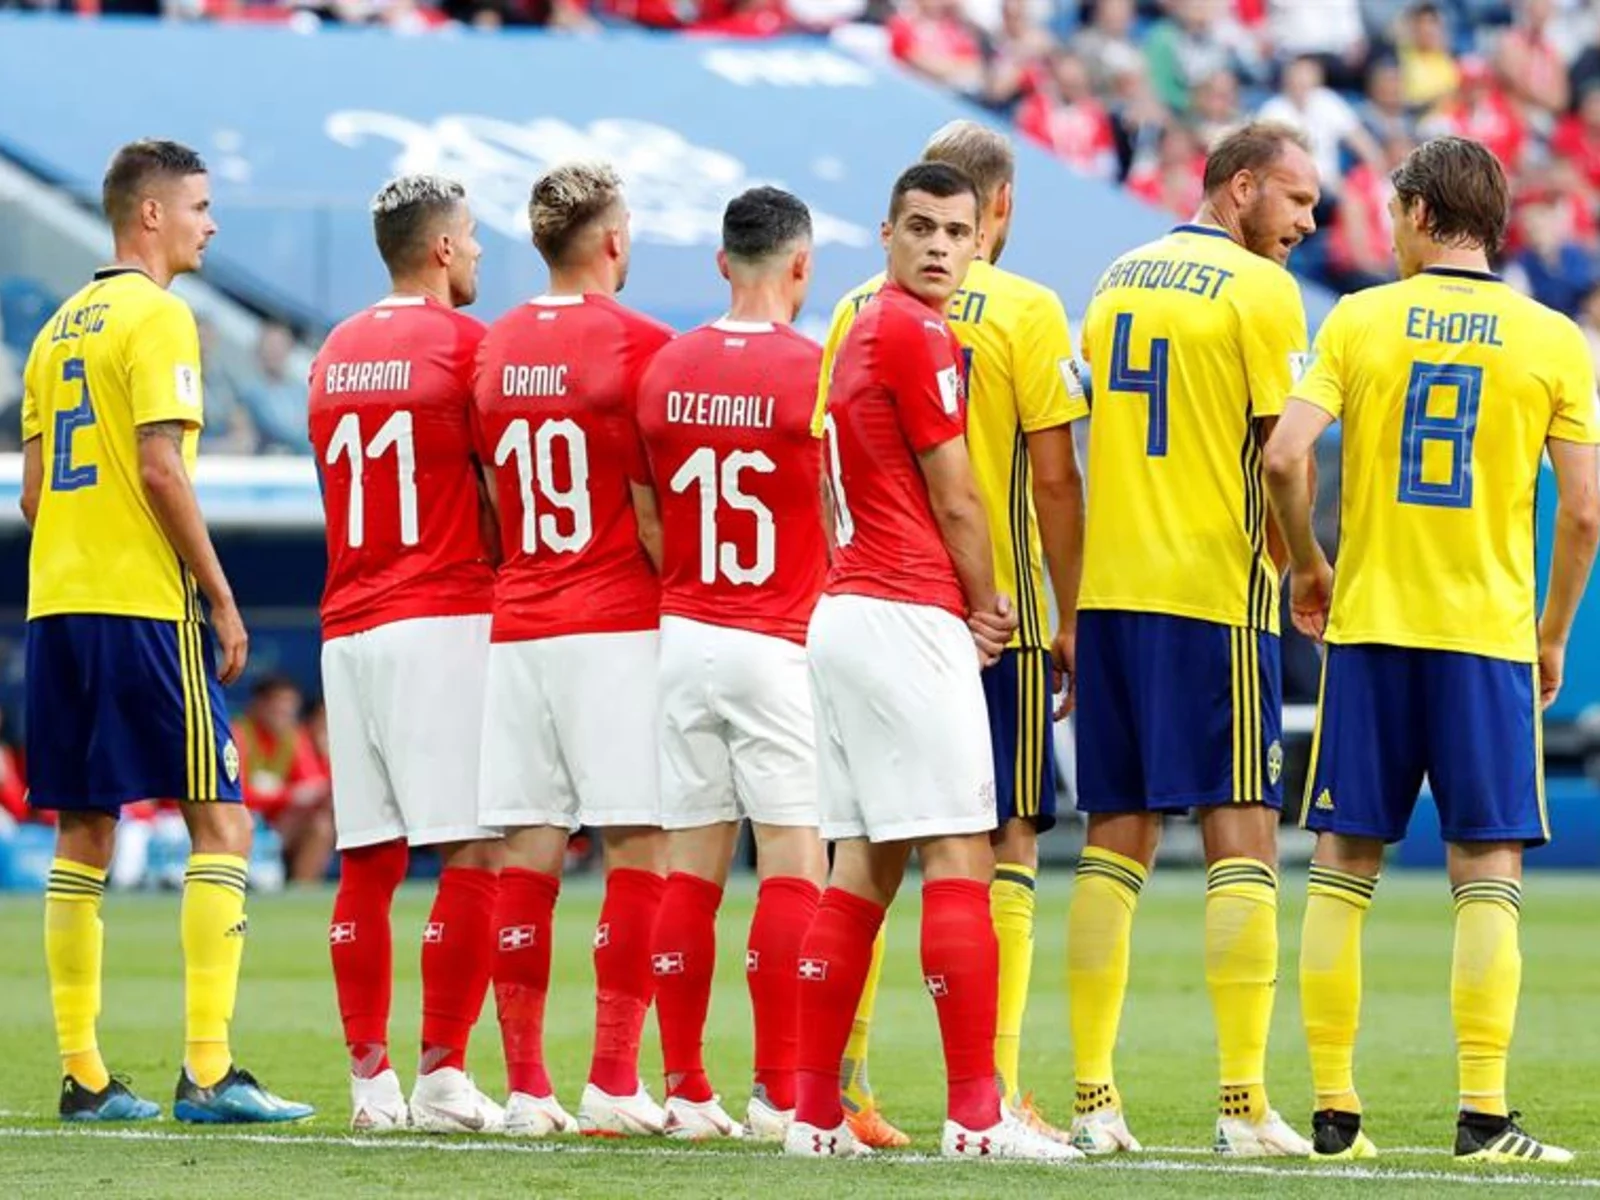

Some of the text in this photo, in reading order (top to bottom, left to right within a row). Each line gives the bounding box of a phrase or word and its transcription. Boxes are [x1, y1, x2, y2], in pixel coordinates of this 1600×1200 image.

[326, 360, 411, 394] BEHRAMI
[1108, 312, 1170, 457] 4
[1406, 306, 1503, 347] EKDAL
[51, 357, 97, 491] 2
[667, 391, 775, 428] DZEMAILI
[1397, 360, 1484, 509] 8
[326, 410, 419, 548] 11
[495, 418, 592, 554] 19
[670, 447, 776, 586] 15
